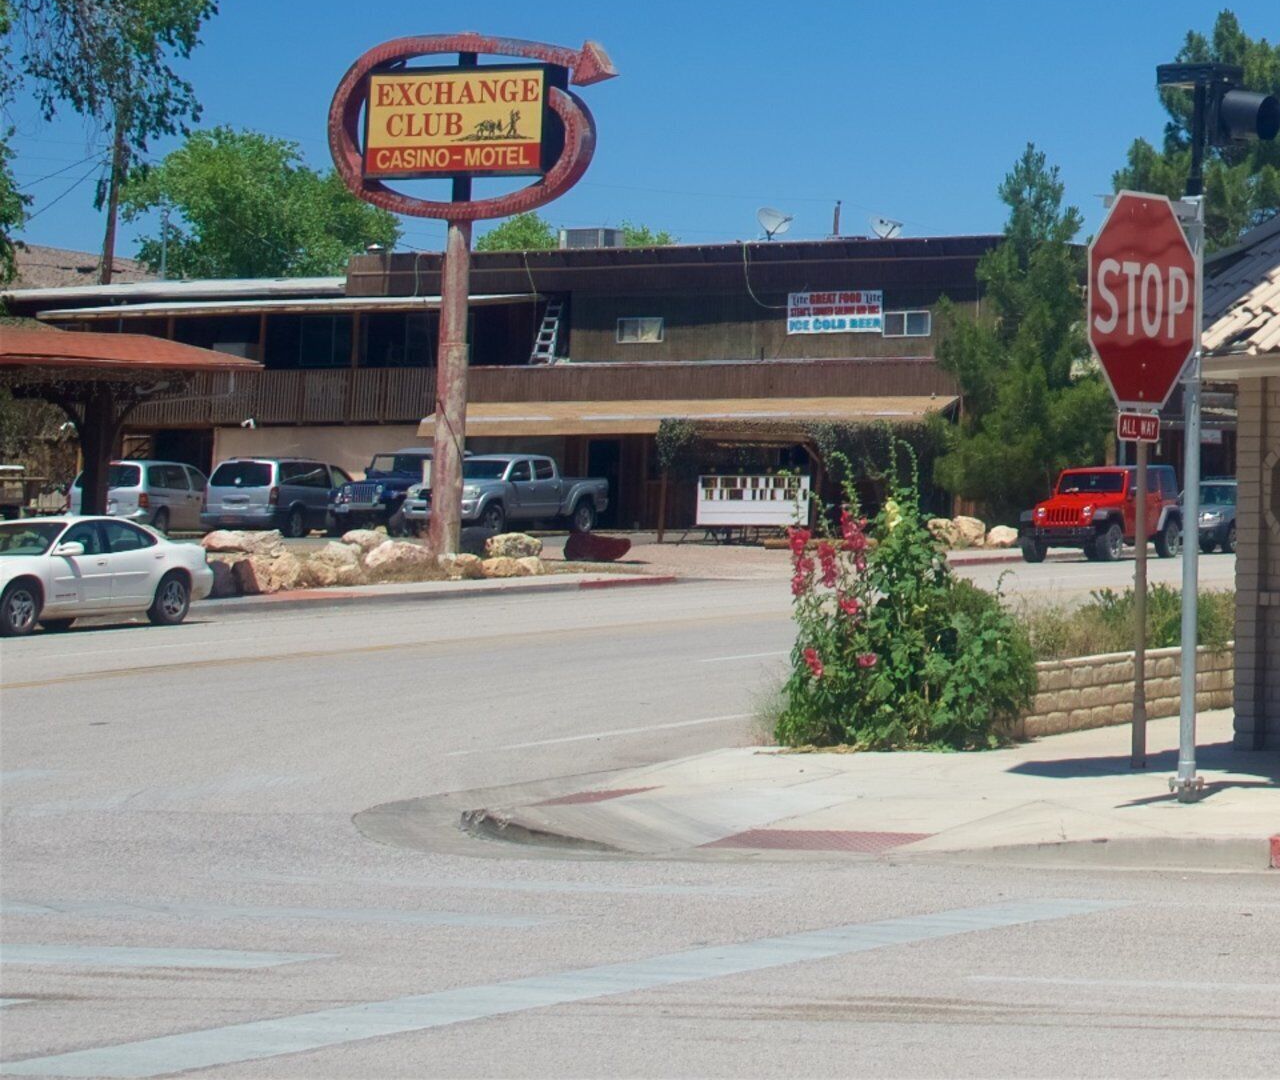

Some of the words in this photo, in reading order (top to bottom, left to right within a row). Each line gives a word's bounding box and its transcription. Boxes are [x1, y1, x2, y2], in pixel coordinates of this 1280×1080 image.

[375, 78, 540, 108] EXCHANGE
[385, 112, 464, 138] CLUB
[809, 293, 836, 305] GREAT
[838, 292, 862, 303] FOOD
[1094, 258, 1189, 339] STOP
[789, 319, 809, 331] ICE
[813, 318, 846, 330] COLD
[849, 317, 881, 328] BEER
[1122, 419, 1137, 436] ALL
[1140, 420, 1157, 437] WAY
